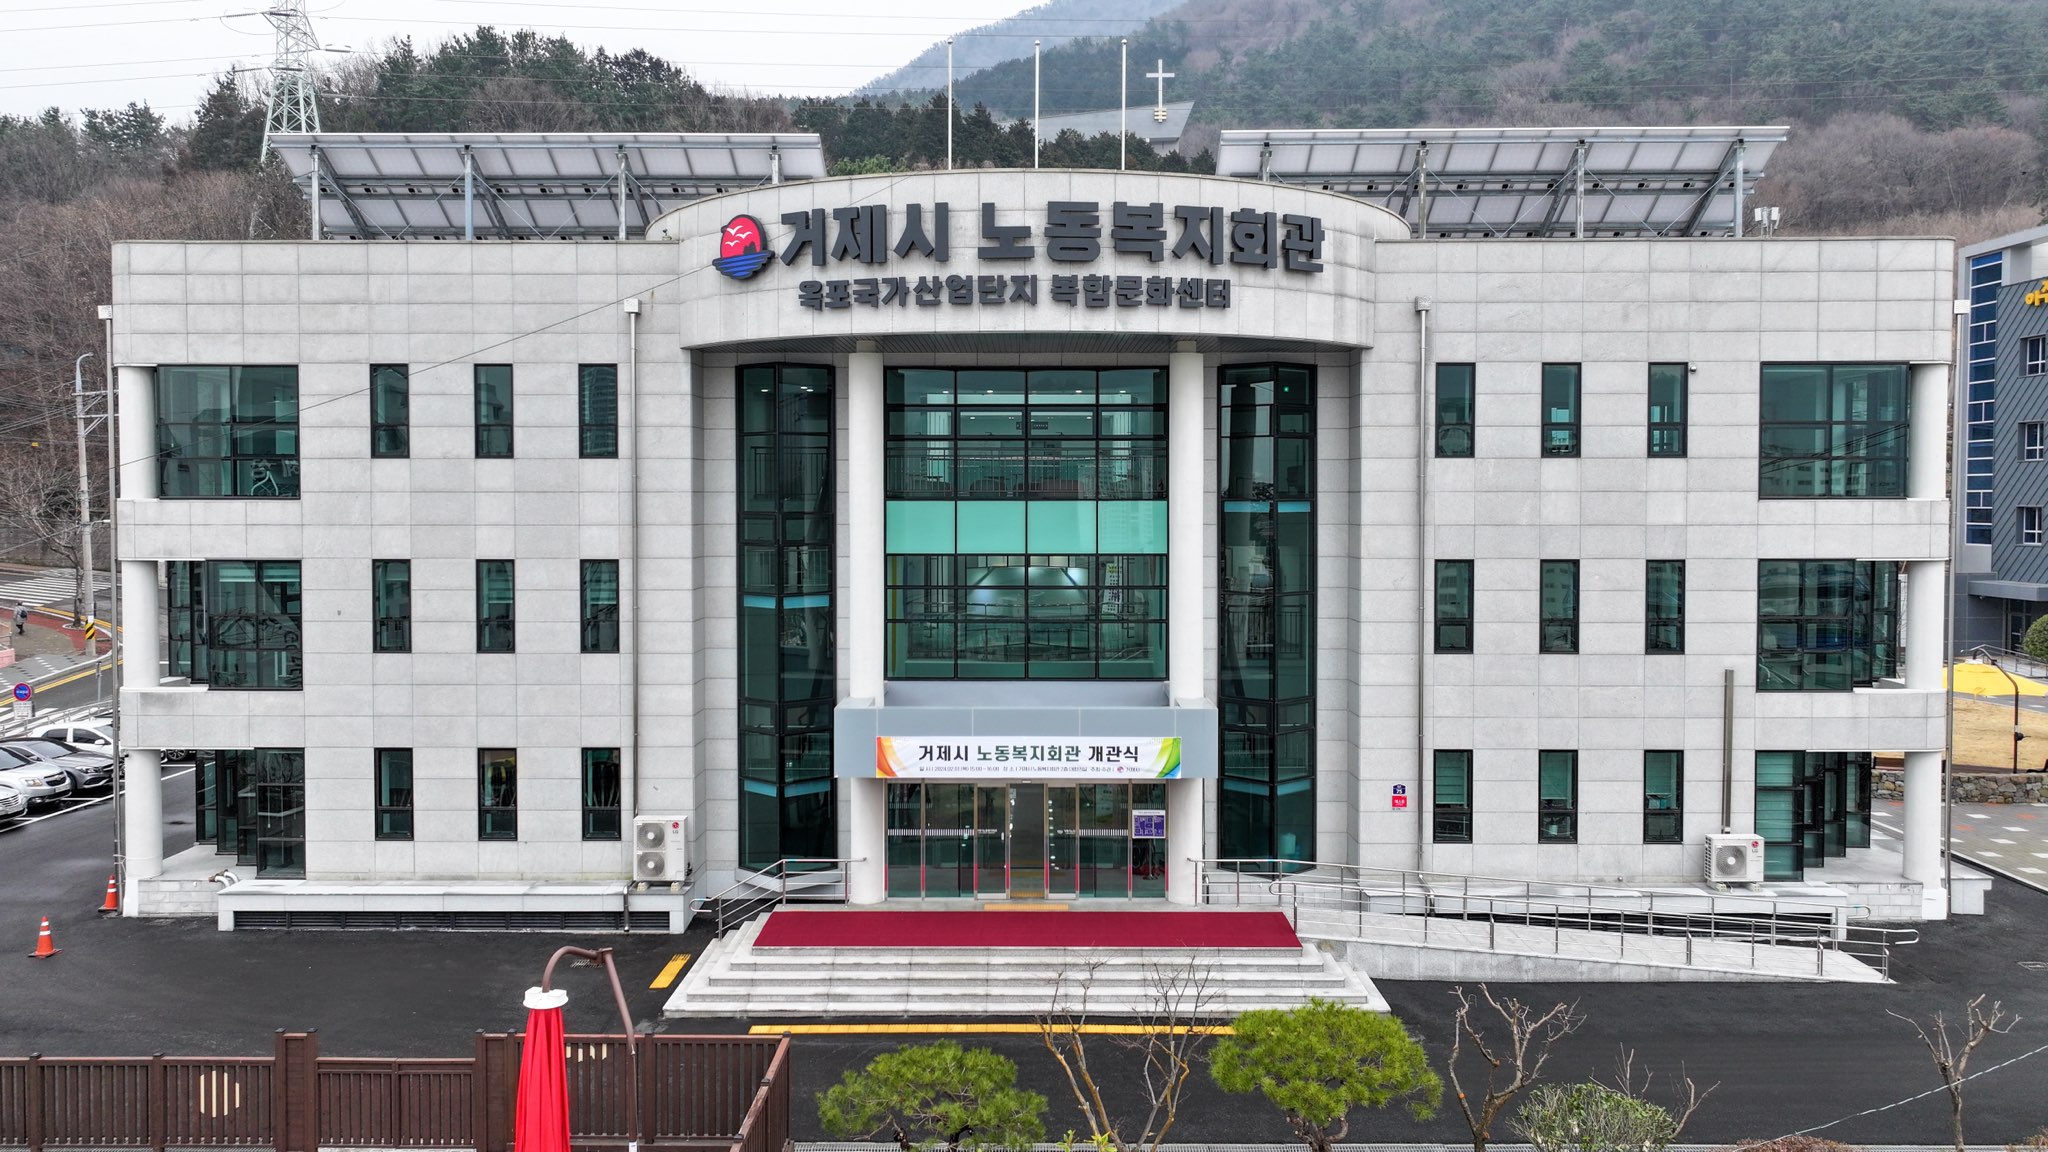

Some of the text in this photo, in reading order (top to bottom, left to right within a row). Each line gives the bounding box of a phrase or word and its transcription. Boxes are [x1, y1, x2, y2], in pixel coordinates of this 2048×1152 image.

[780, 200, 1325, 273] 거제시 노동복지회관
[797, 274, 1232, 311] 옥포국가산업단지 복합문화센터
[918, 745, 1139, 763] 거제시 노동복지회관 개관식
